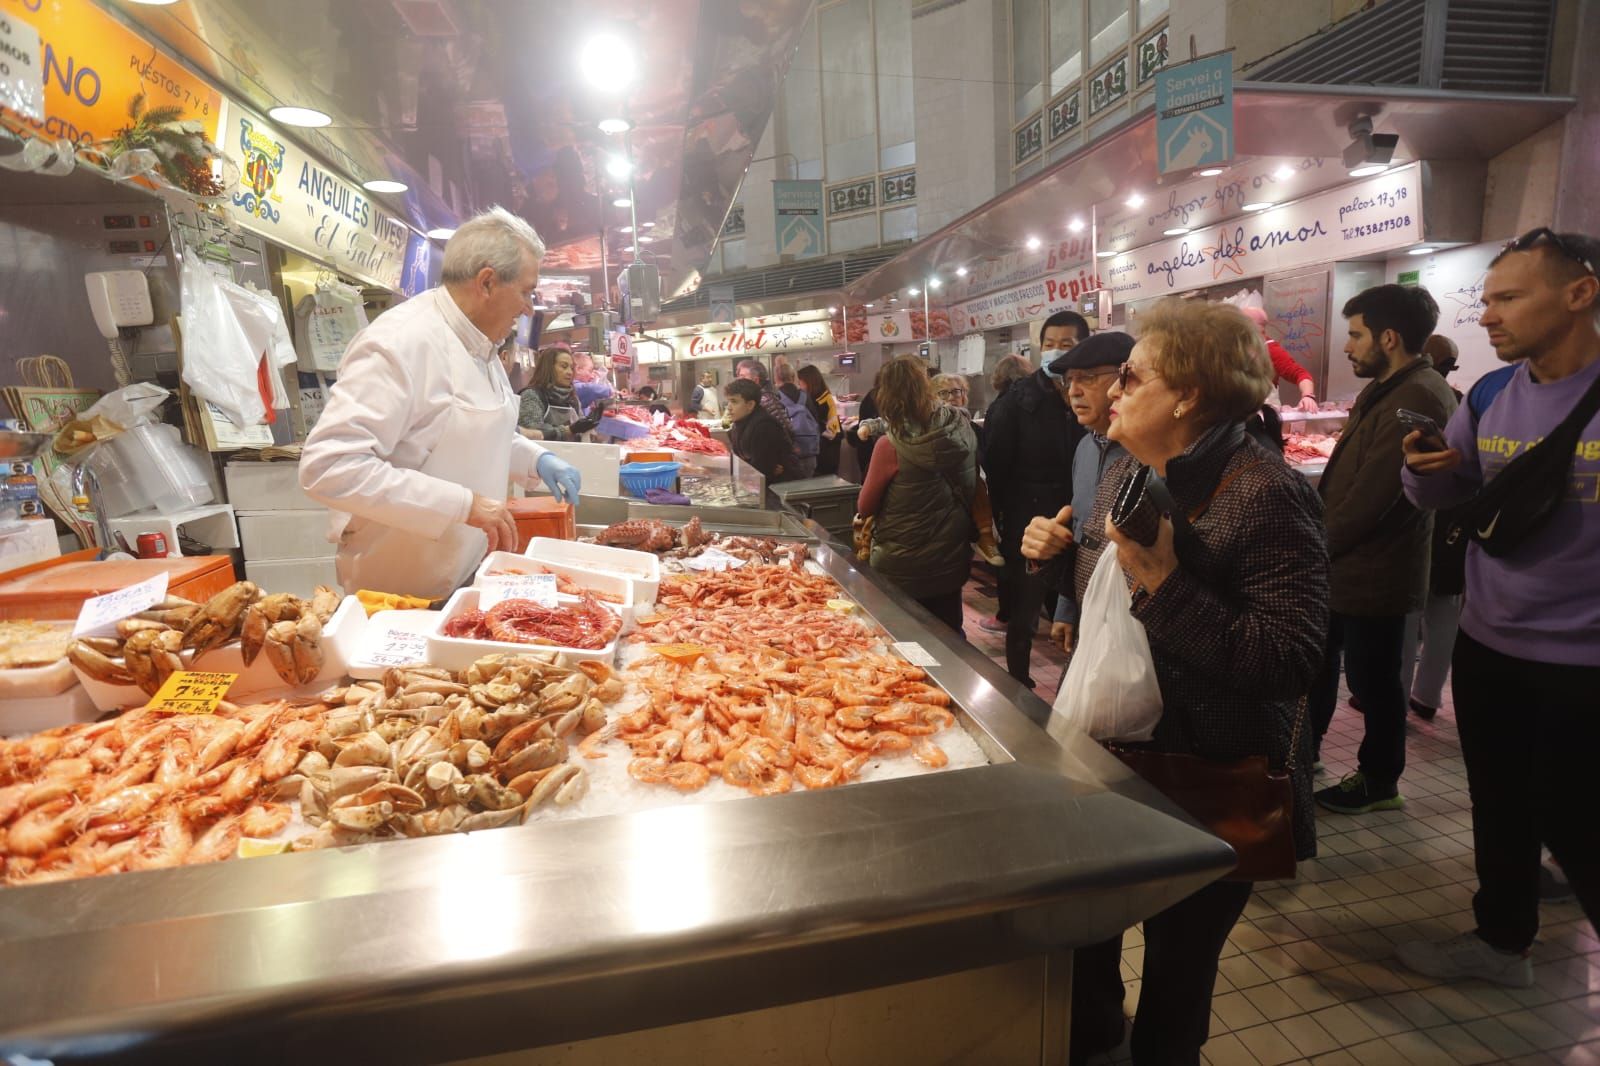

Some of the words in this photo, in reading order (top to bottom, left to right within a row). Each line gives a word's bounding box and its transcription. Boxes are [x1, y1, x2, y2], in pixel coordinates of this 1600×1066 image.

[130, 55, 181, 98] PUESTOS
[183, 90, 191, 103] 7
[202, 103, 209, 116] 8
[1167, 70, 1209, 93] Servei
[298, 161, 370, 228] ANGUILES
[374, 209, 403, 250] VIVES
[1339, 196, 1376, 224] palcos
[1377, 192, 1388, 206] 17
[1395, 187, 1407, 201] 18
[1147, 242, 1206, 287] angeles
[1213, 226, 1244, 261] del
[1250, 220, 1327, 252] amor
[689, 329, 768, 357] Guillot
